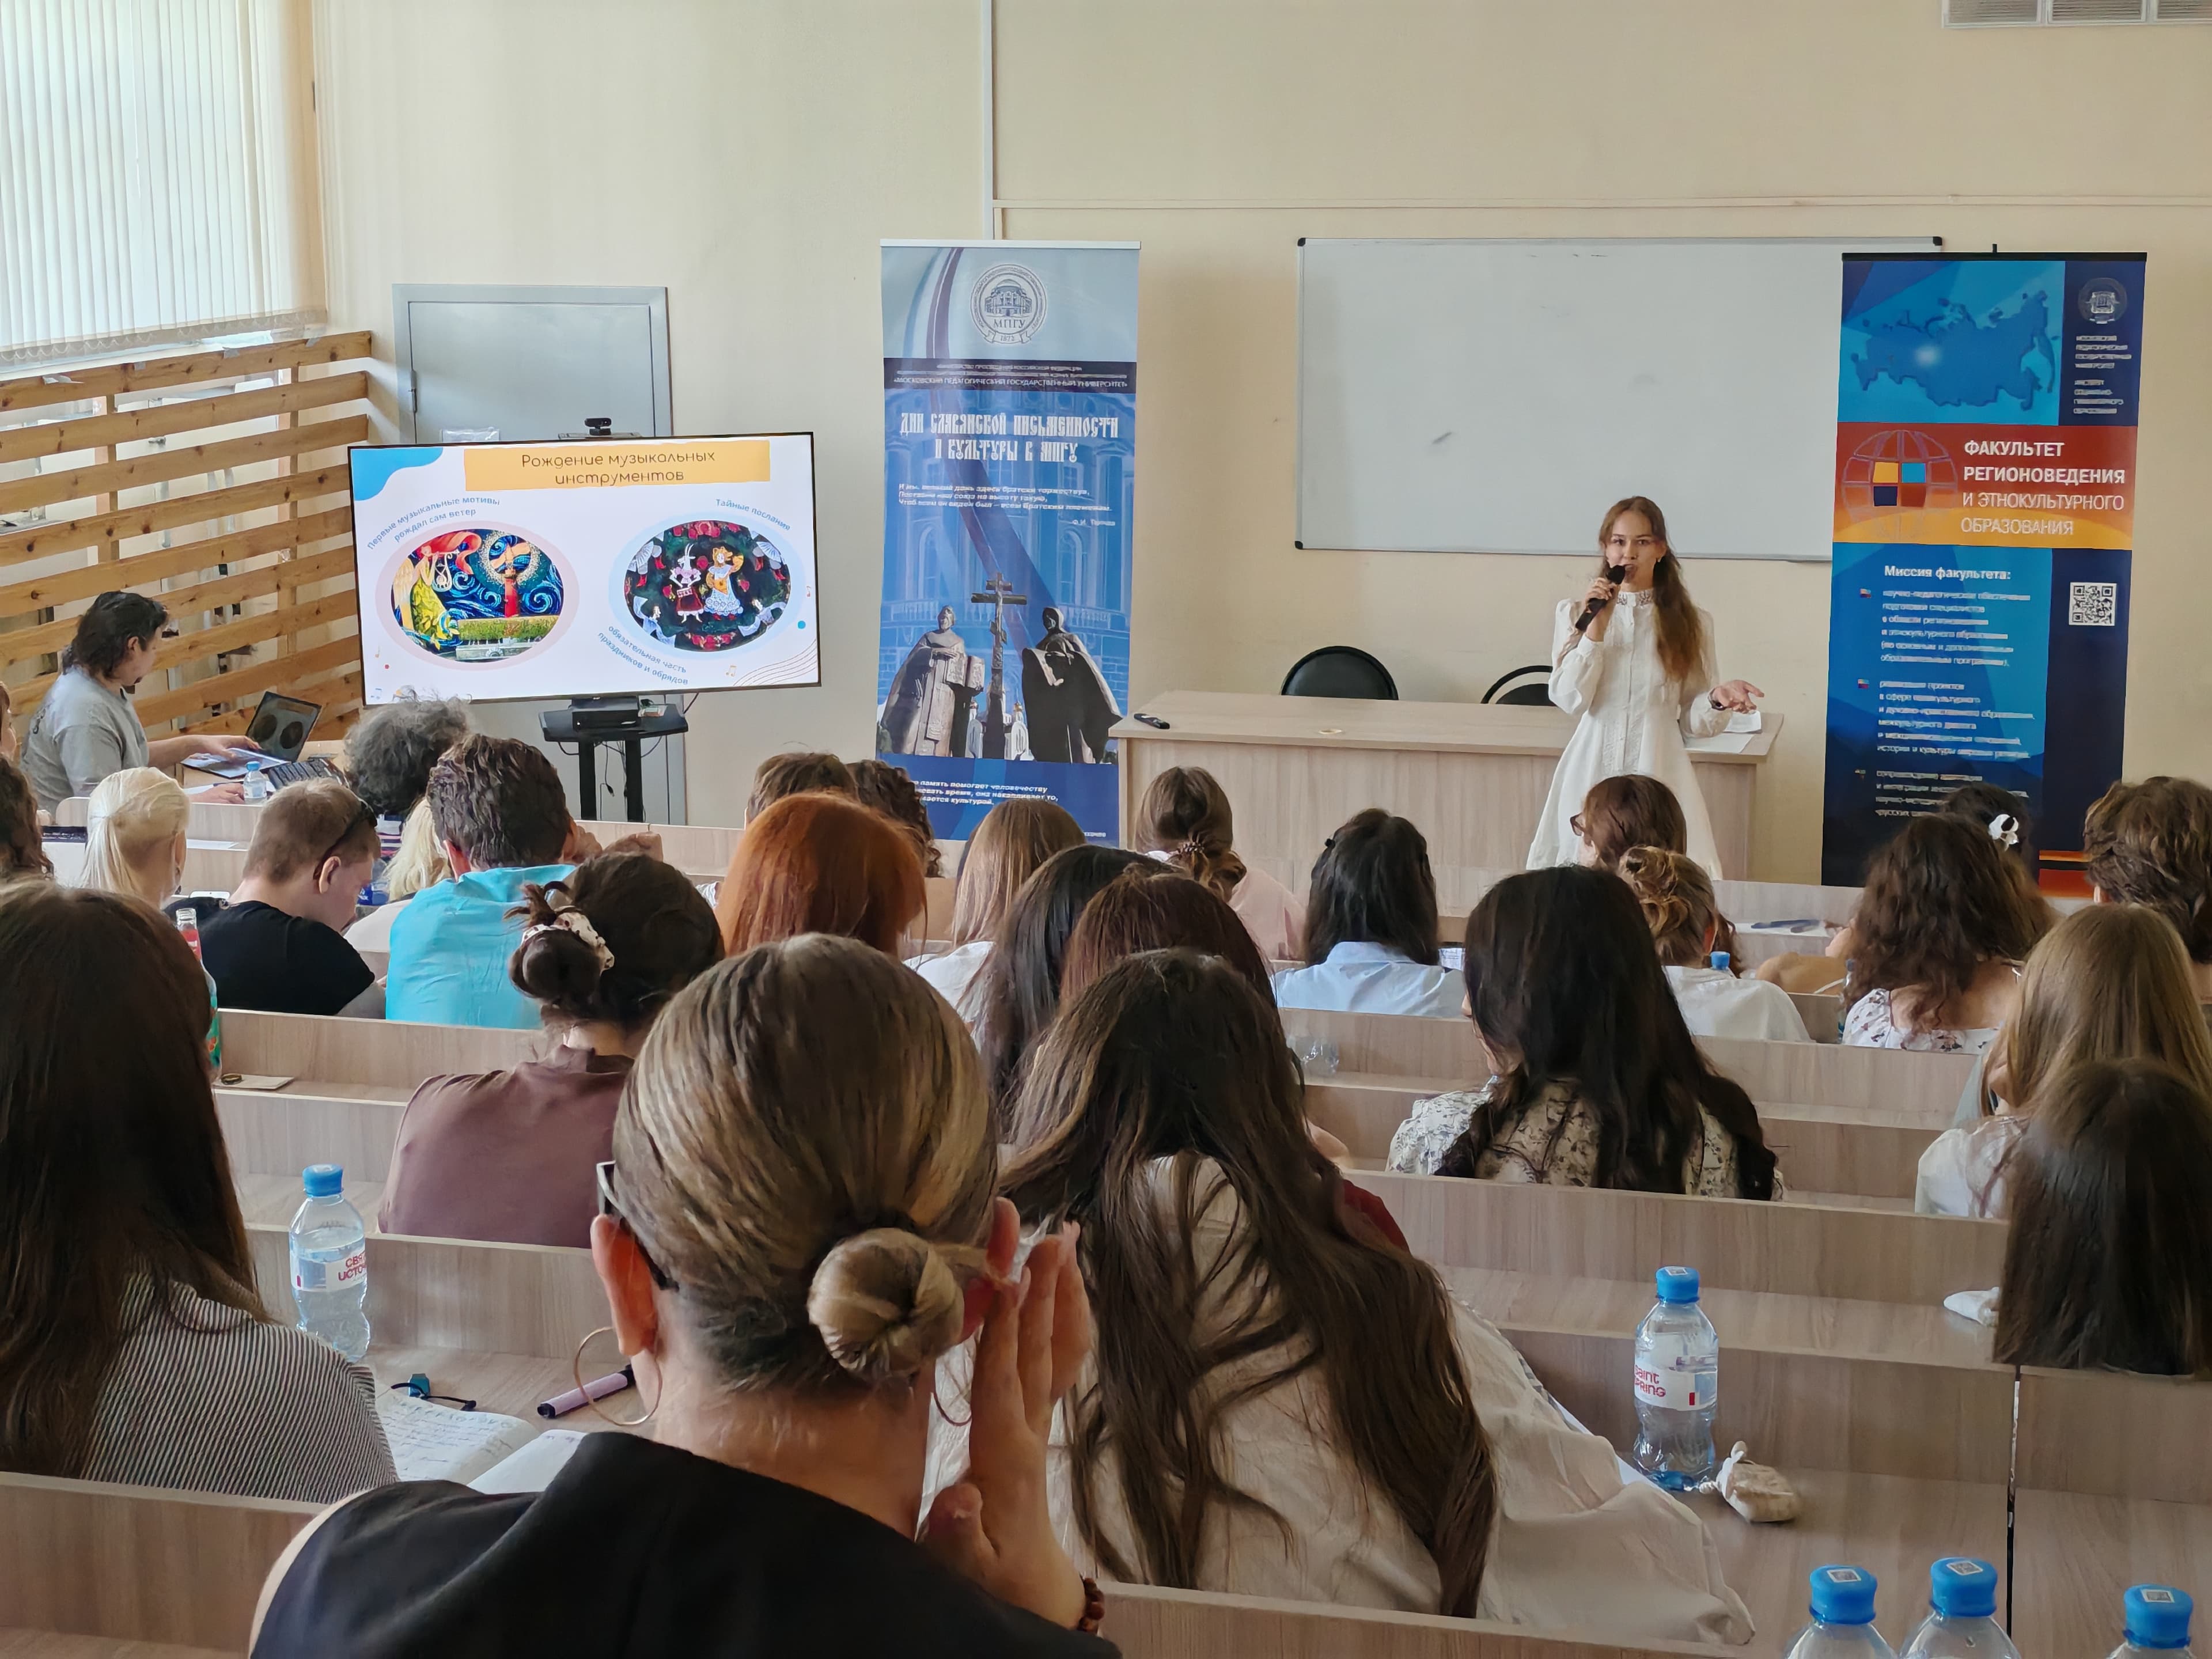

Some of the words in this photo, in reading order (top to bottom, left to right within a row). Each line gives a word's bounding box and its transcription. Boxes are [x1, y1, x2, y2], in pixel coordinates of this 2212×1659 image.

[994, 319, 1025, 328] МПГУ
[900, 412, 924, 436] ДНИ
[931, 412, 1006, 435] СЛАВЯНСКОЙ
[1013, 415, 1118, 438] ПИСЬМЕННОСТИ
[948, 439, 1018, 461] КУЛЬТУРЫ
[1025, 441, 1033, 461] В
[1040, 441, 1078, 463] МПГУ
[1964, 440, 2065, 456] ФАКУЛЬТЕТ
[522, 454, 603, 469] Рождение
[609, 452, 715, 468] музыкальных
[555, 471, 684, 487] инструментов
[1964, 467, 2125, 486] РЕГИОНОВЕДЕНИЯ
[1963, 493, 1973, 507] И
[1978, 493, 2124, 510] ЭТНОКУЛЬТУРНОГО
[367, 523, 396, 550] Первые
[397, 498, 460, 524] музыкальные
[463, 497, 500, 505] мотивы
[716, 499, 749, 512] Тайные
[751, 508, 790, 531] послания
[393, 520, 427, 543] рождал
[429, 513, 446, 523] сам
[449, 509, 476, 518] ветер
[1961, 517, 2074, 535] ОБРАЗОВАНИЯ
[1884, 565, 1932, 577] Миссия
[1936, 567, 2011, 581] факультета:
[598, 632, 643, 668] праздников
[652, 669, 688, 685] обрядов
[608, 626, 661, 664] обязательная
[662, 661, 686, 673] часть
[991, 785, 1048, 794] человечеству
